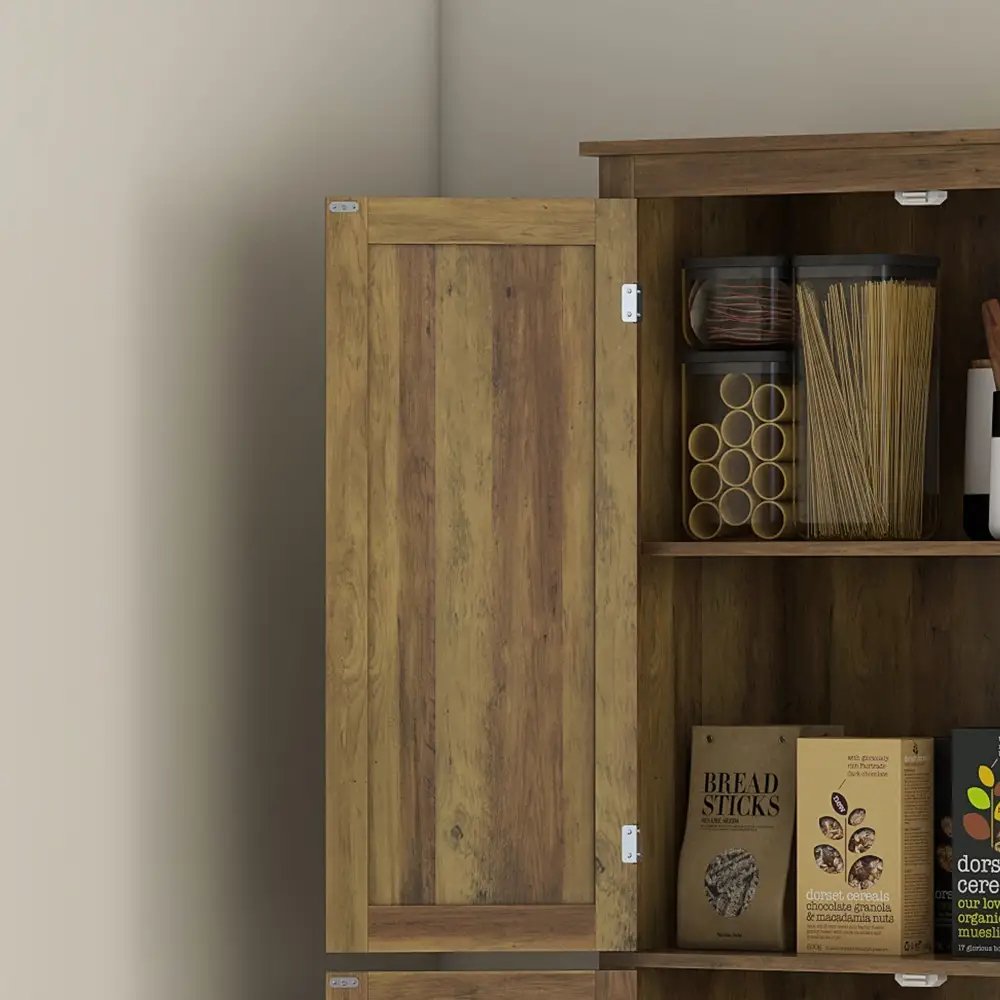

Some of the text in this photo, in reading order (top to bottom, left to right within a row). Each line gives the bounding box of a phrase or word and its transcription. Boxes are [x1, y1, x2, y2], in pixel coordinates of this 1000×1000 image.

[704, 772, 778, 794] BREAD
[702, 794, 780, 816] STICKS
[806, 889, 890, 902] dorset cereals
[806, 901, 892, 913] chocolate granola
[958, 900, 980, 910] our
[806, 912, 894, 923] & macadamia nuts
[958, 927, 1000, 939] muesli
